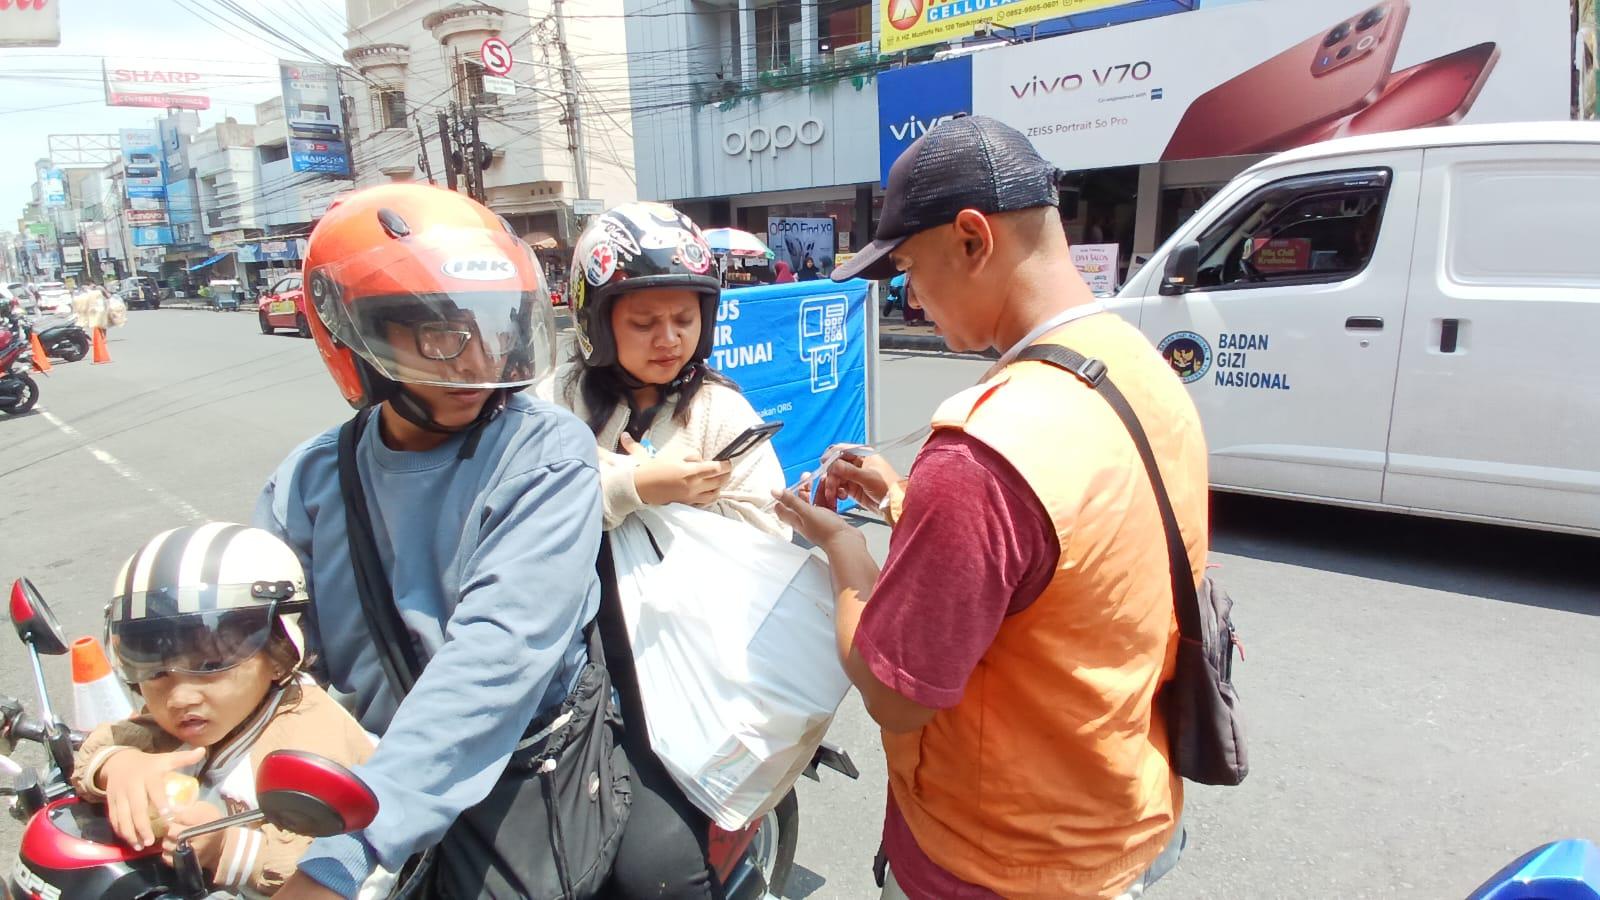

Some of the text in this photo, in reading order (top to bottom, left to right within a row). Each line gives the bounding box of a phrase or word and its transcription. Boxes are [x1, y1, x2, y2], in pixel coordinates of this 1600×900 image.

[115, 69, 201, 83] SHARP
[1010, 60, 1152, 99] vivo V70
[889, 115, 956, 141] viv
[1027, 116, 1128, 137] ZEISS Portrait So Pro
[722, 117, 825, 161] oppo
[453, 259, 509, 273] INK
[1218, 333, 1269, 350] BADAN
[713, 341, 773, 371] TUNAI
[1216, 352, 1246, 368] GIZI
[1215, 371, 1290, 390] NASIONAL
